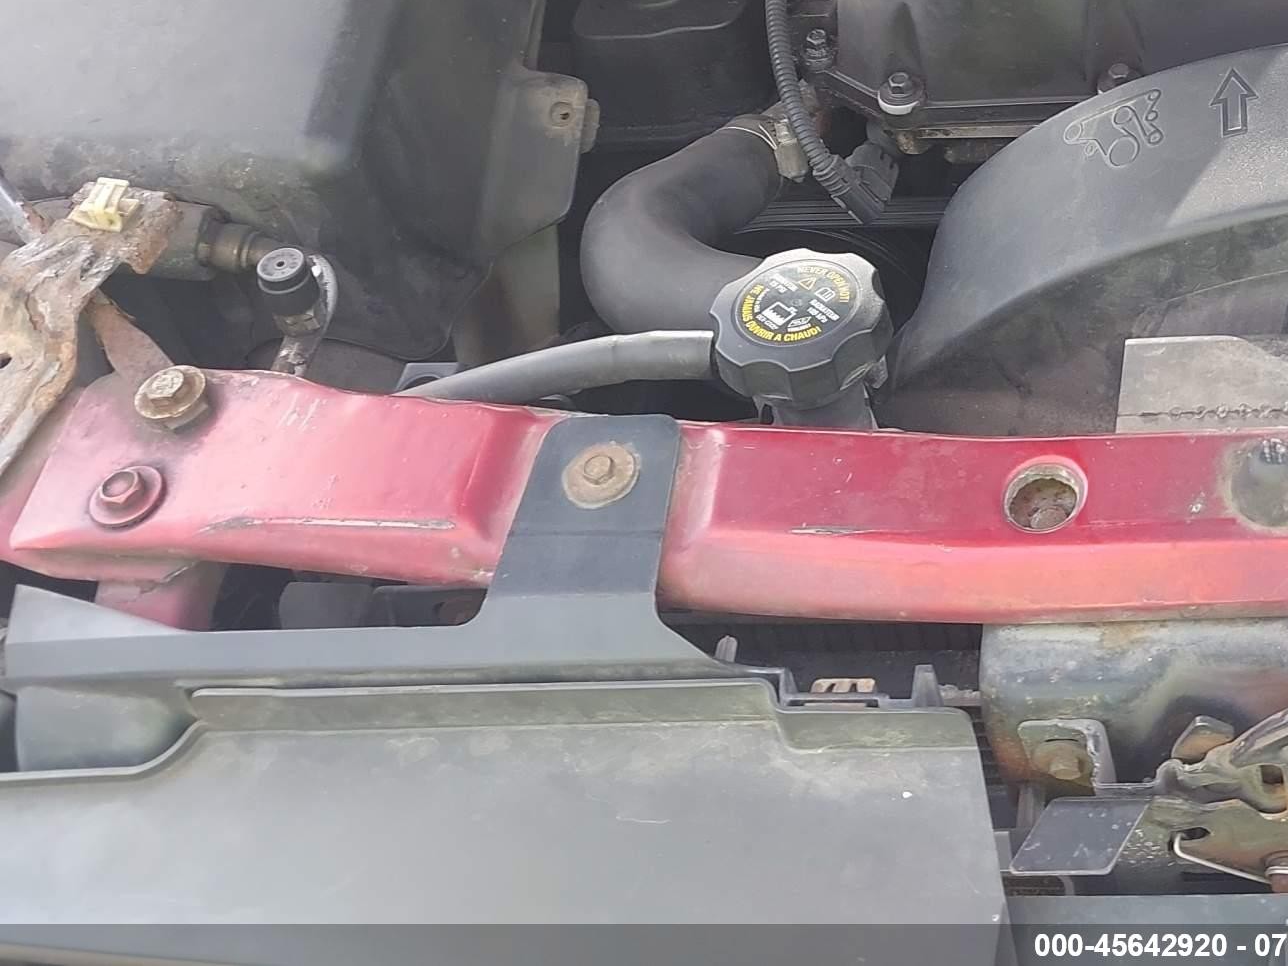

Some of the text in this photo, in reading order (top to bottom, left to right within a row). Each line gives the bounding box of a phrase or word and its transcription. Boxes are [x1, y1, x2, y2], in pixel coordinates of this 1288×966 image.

[797, 266, 827, 276] NEVER
[741, 294, 755, 322] JAMAIS
[746, 321, 774, 340] OUVRIR
[784, 326, 821, 342] CHAUD!
